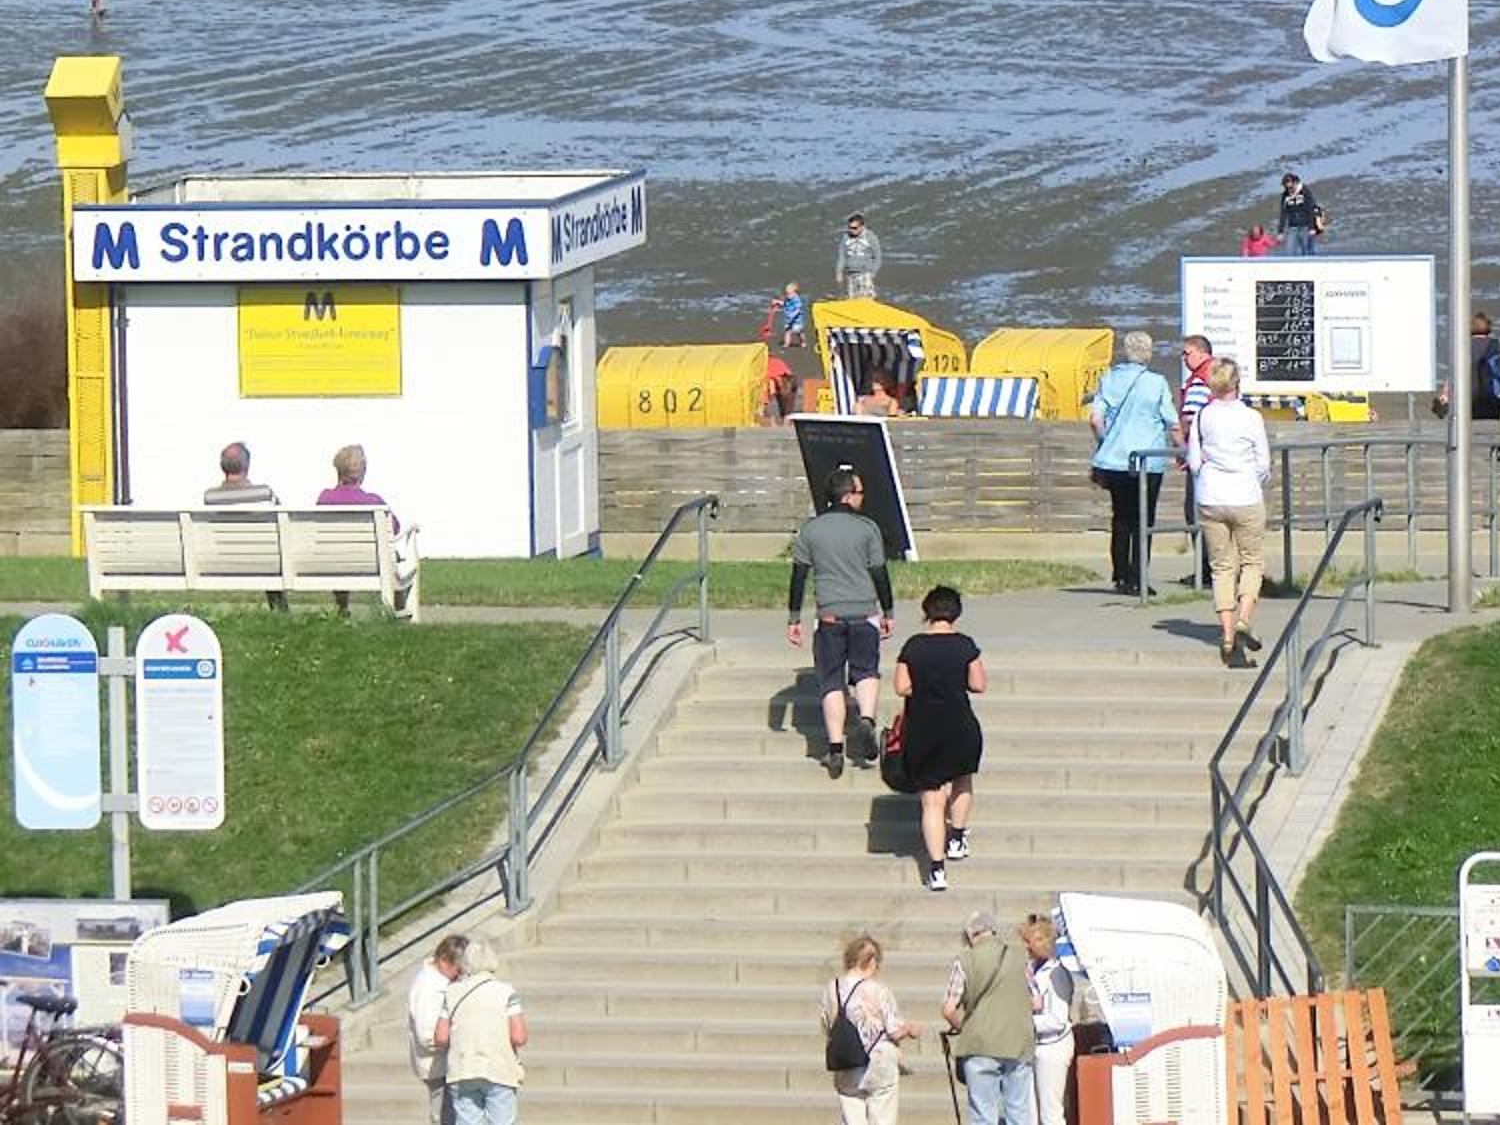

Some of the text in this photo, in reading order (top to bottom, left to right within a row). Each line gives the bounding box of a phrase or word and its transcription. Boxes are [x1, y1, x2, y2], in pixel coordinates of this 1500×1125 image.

[92, 218, 528, 269] M Strandkörbe M
[564, 196, 627, 252] Strandkörbe
[304, 292, 336, 321] M
[639, 387, 702, 413] 802
